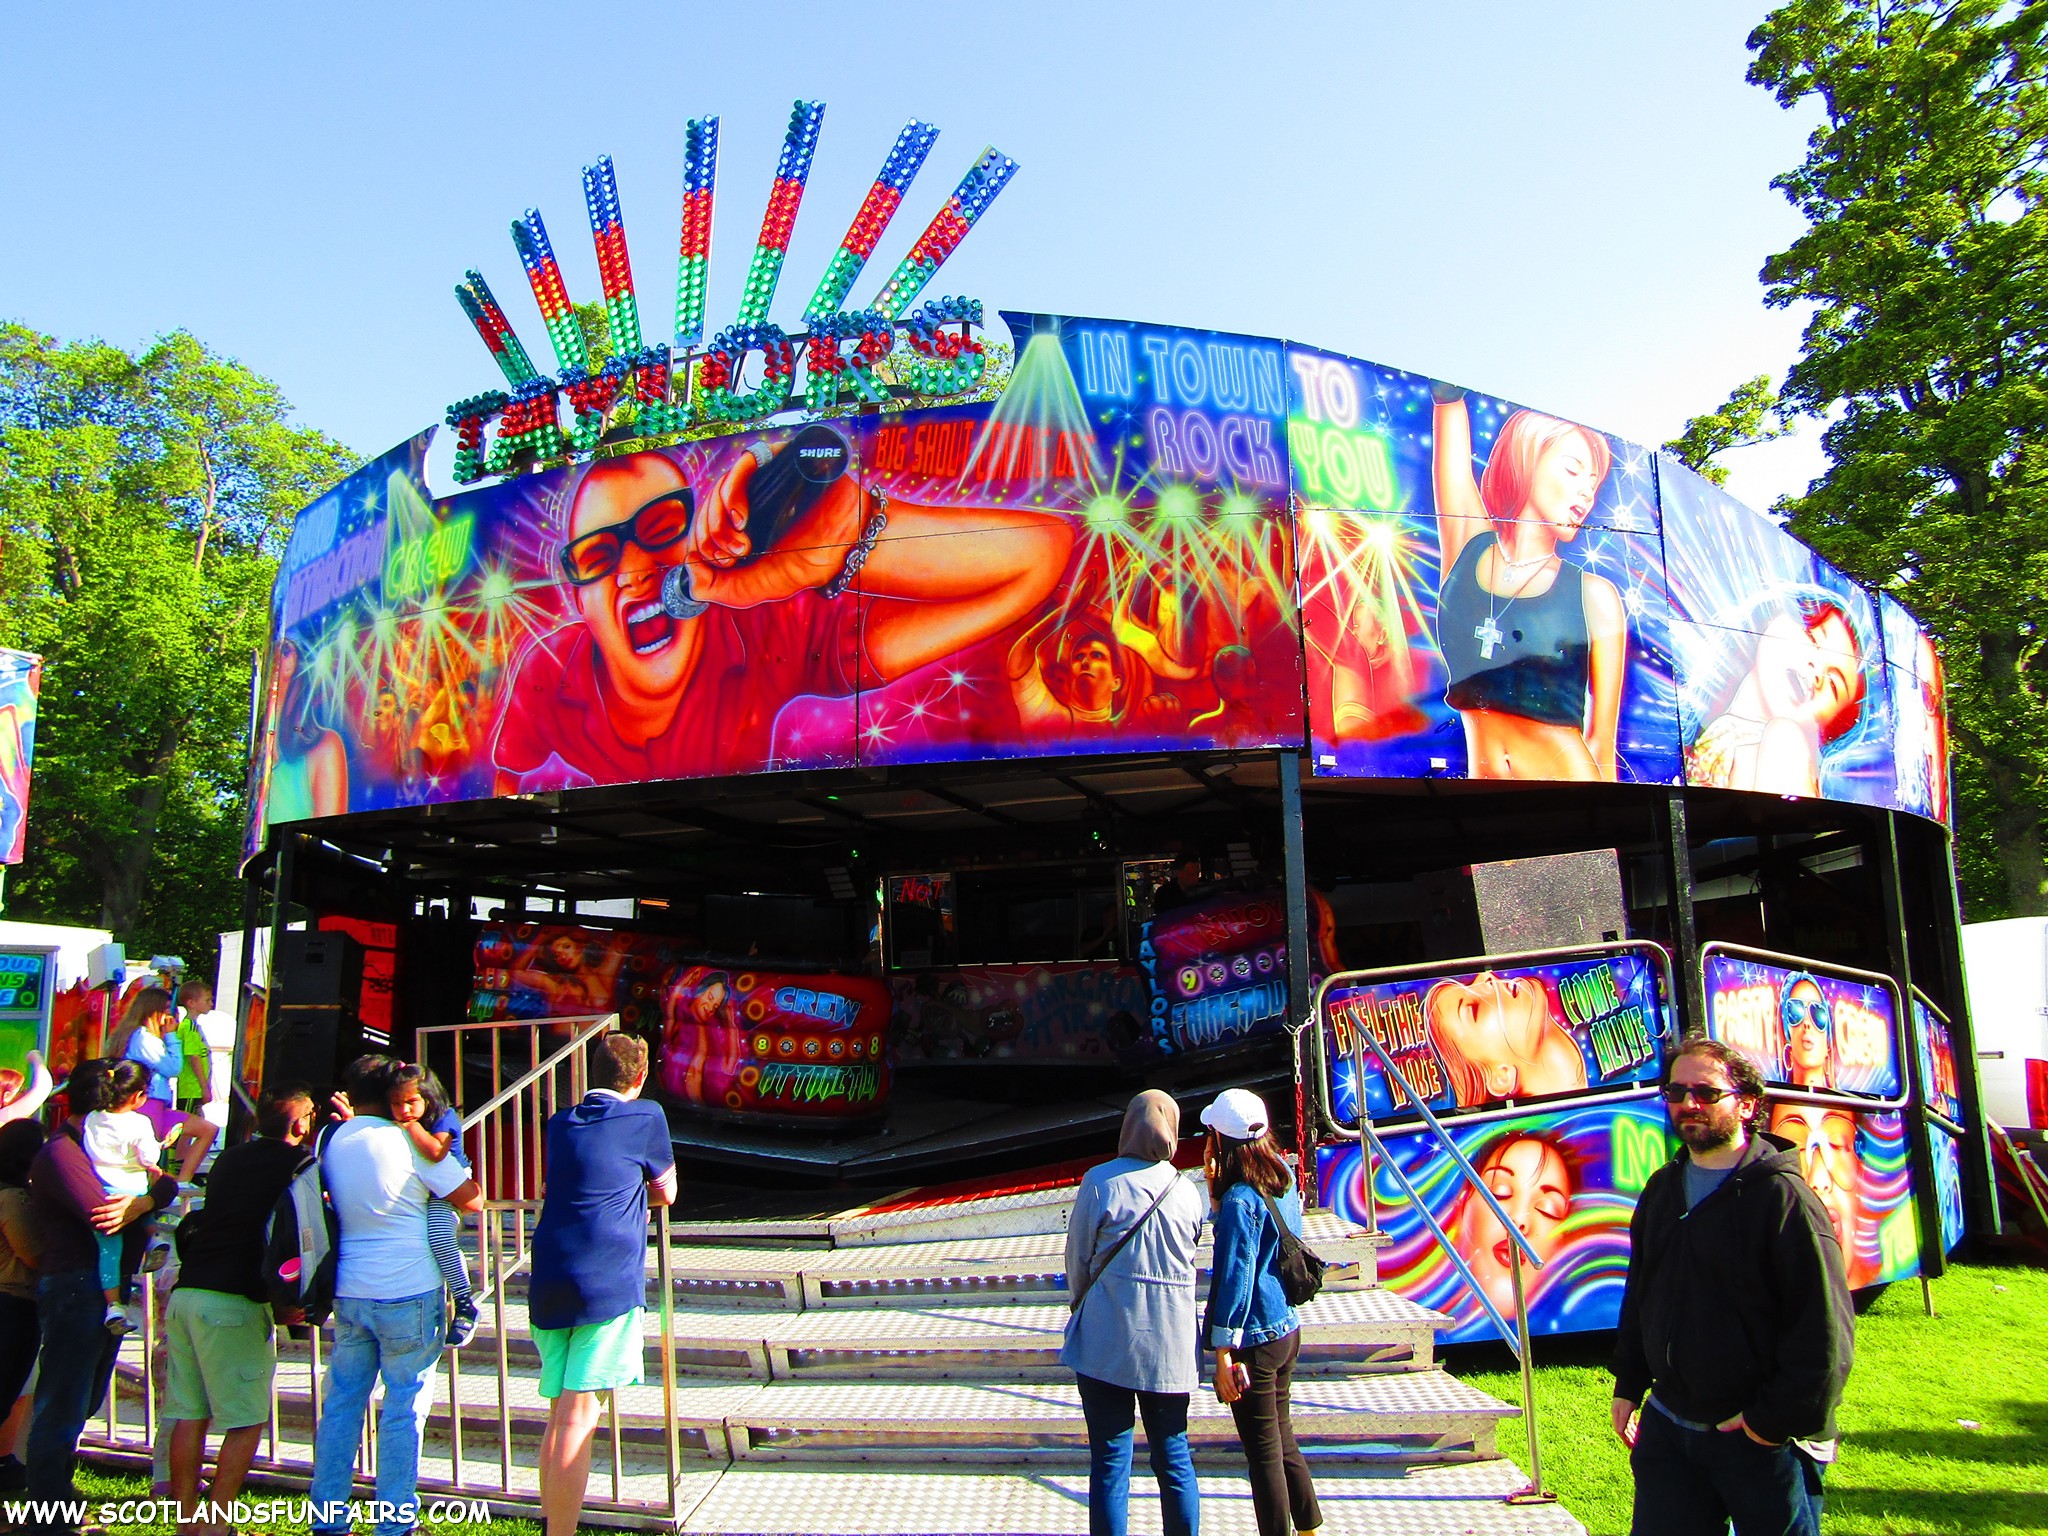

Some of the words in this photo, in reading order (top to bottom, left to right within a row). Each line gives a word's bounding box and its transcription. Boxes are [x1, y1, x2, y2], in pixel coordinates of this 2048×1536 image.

[445, 294, 987, 485] TAYLORS
[1081, 331, 1133, 397] IN
[1146, 337, 1284, 416] TOWN
[1292, 353, 1358, 429] TO
[799, 447, 842, 458] SHURE
[875, 425, 909, 472] BIG
[911, 420, 976, 478] SHOUT
[976, 420, 1052, 482] COMING
[1152, 407, 1280, 486] ROCK
[1291, 422, 1394, 509] YOU
[386, 518, 472, 600] CREW
[775, 986, 861, 1029] CREW
[1139, 920, 1175, 1056] TAYLORS
[1181, 968, 1198, 991] 9
[1559, 963, 1621, 1031] COME
[869, 1034, 880, 1056] 8
[1379, 991, 1427, 1055] THE
[1590, 1006, 1654, 1081] ALIVE
[1713, 984, 1776, 1055] PARTY
